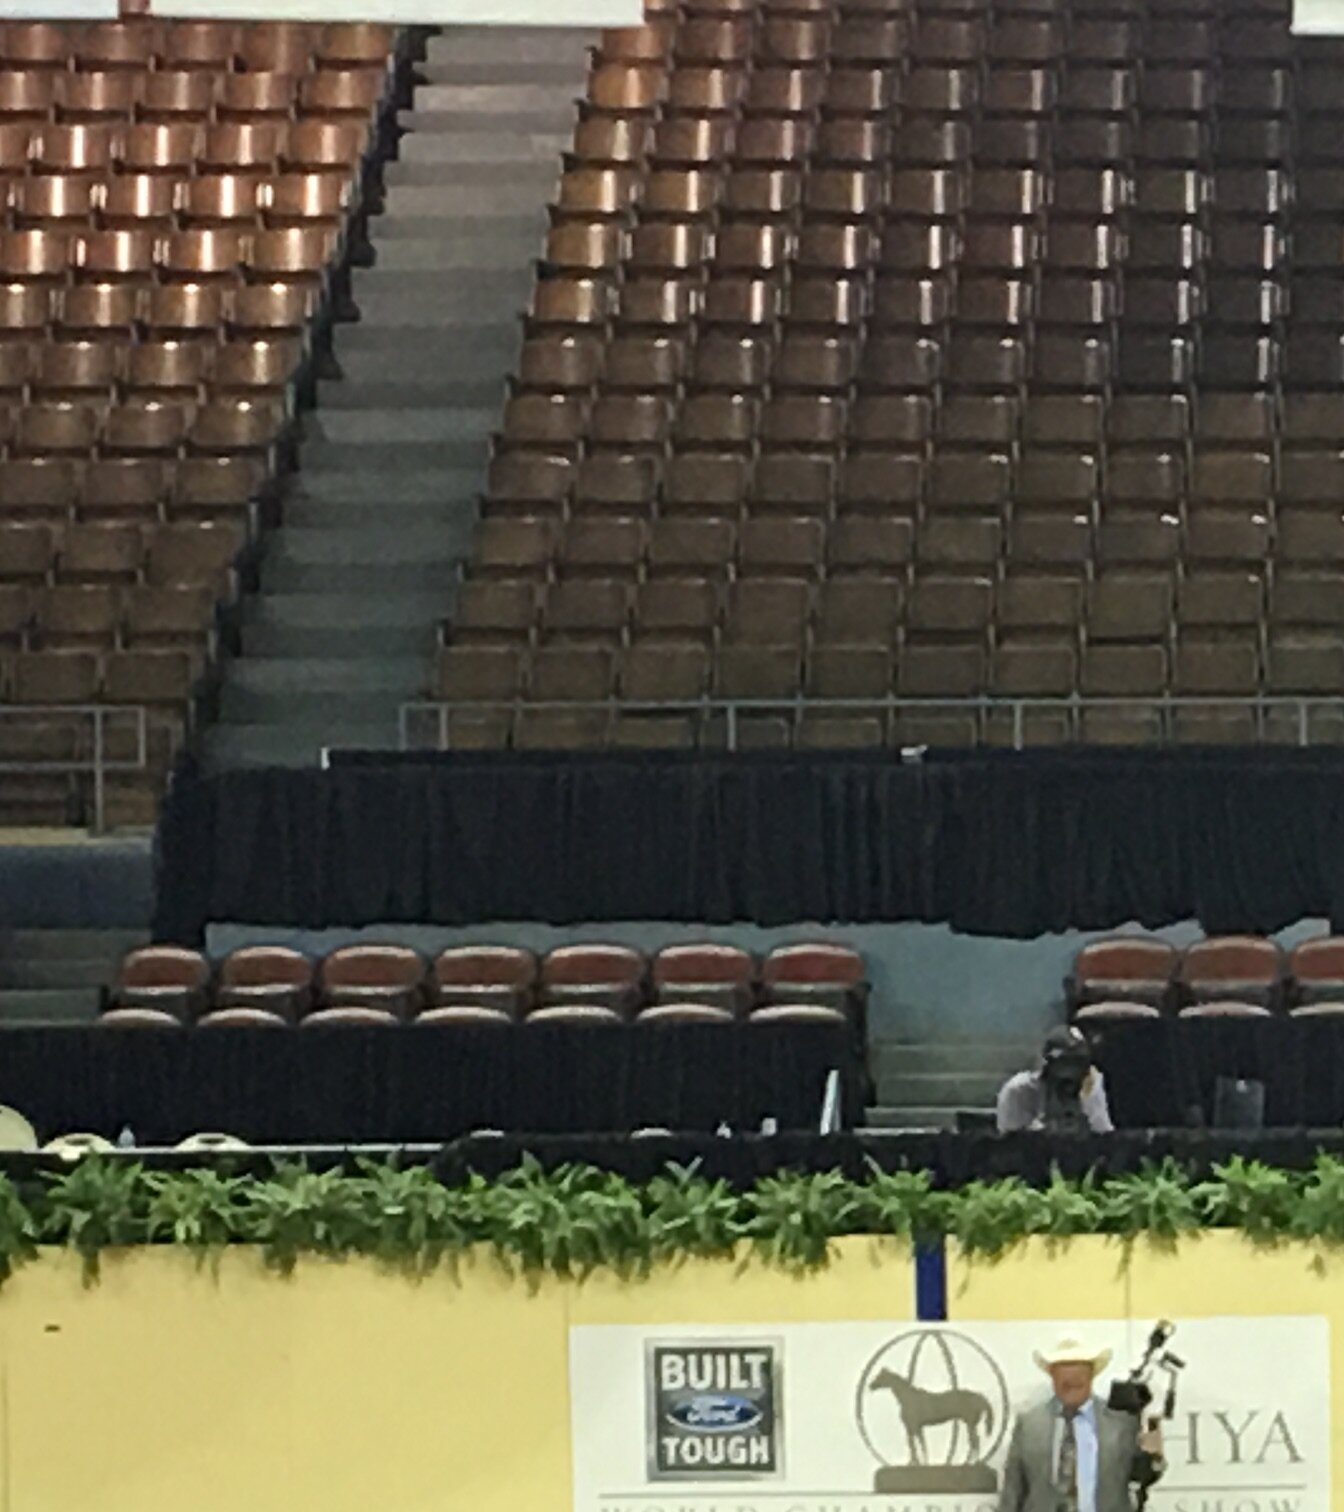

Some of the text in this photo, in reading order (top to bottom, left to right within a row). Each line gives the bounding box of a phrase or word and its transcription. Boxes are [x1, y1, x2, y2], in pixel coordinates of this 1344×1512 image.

[661, 1353, 768, 1391] BUILT
[661, 1435, 770, 1466] TOUGH
[1163, 1409, 1306, 1465] HYA
